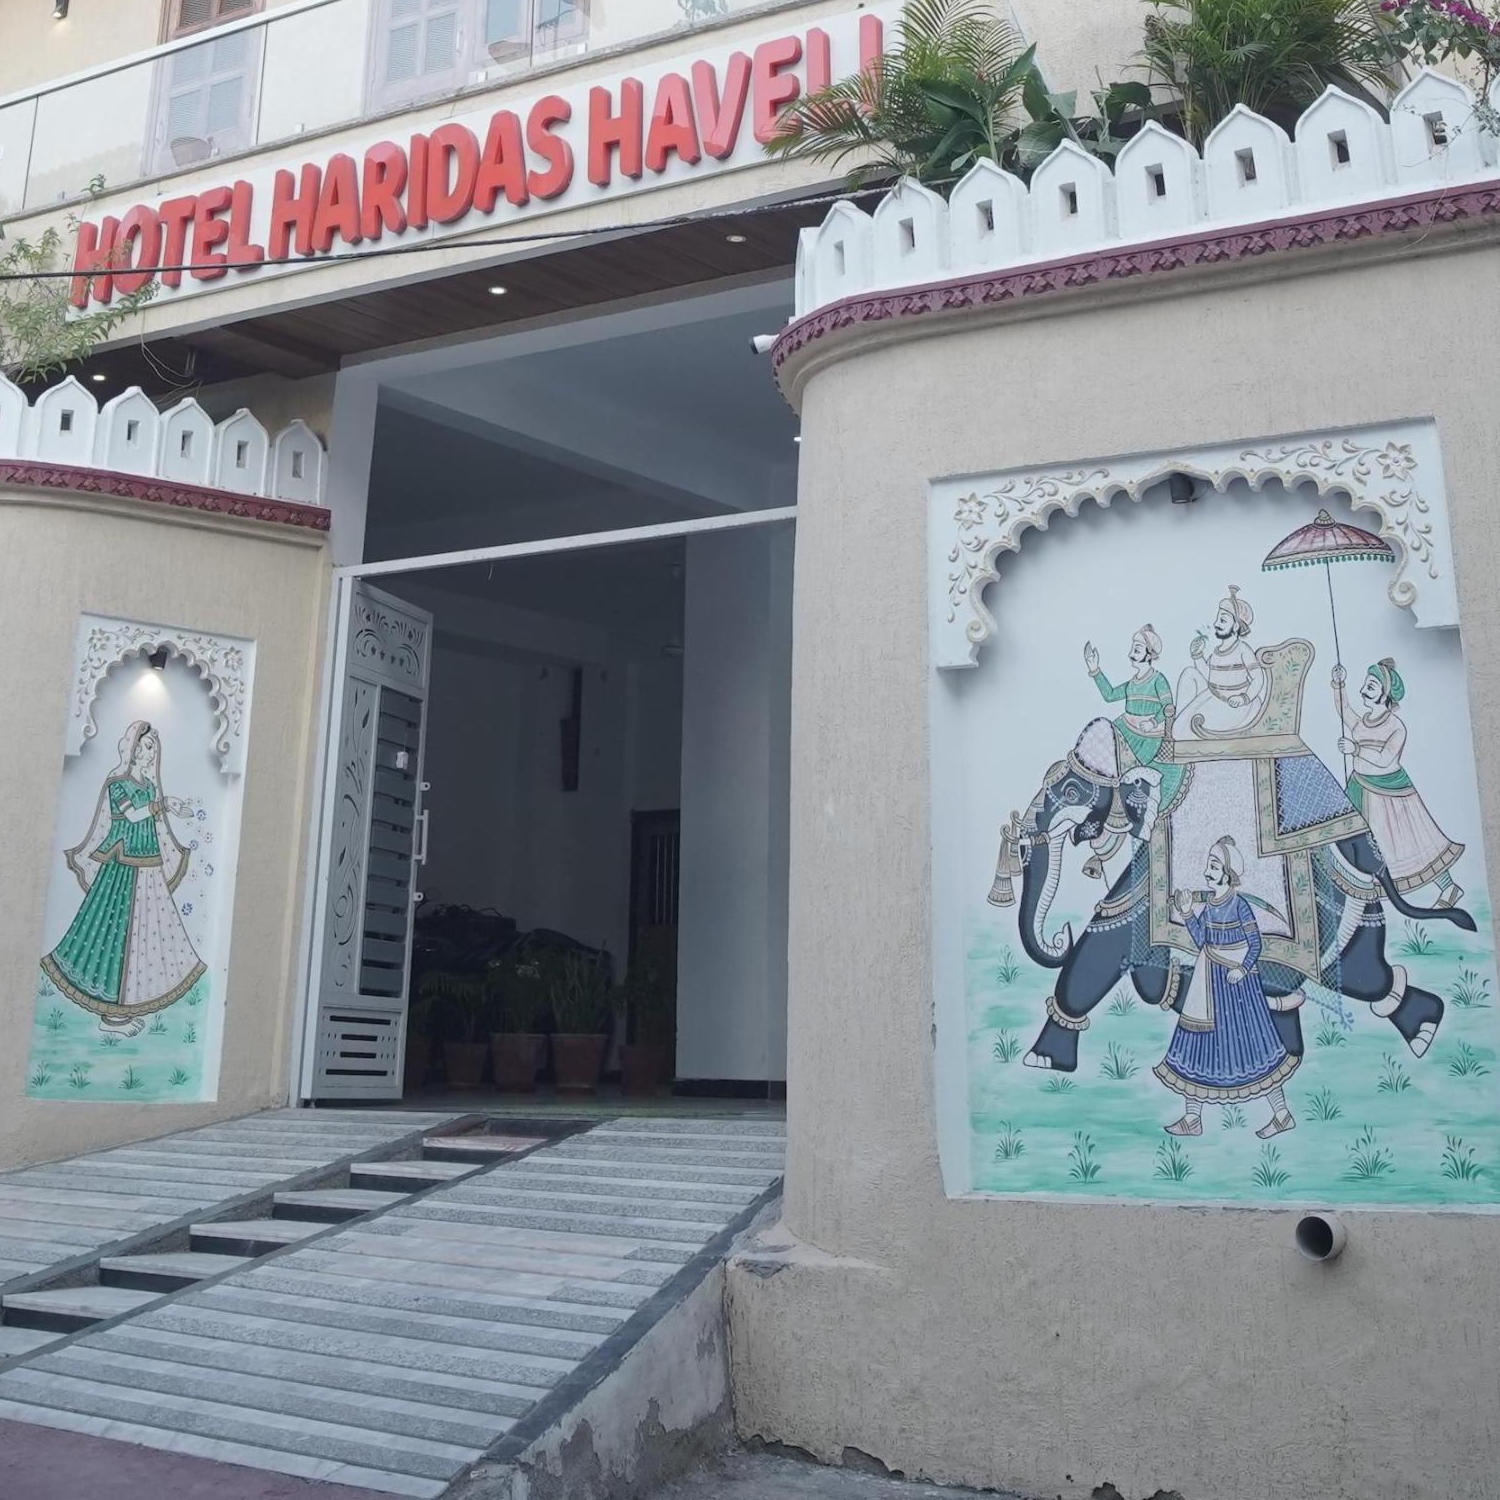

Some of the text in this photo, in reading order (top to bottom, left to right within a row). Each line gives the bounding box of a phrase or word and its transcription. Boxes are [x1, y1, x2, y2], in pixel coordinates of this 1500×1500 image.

[69, 13, 884, 309] HOTEL HARIDAS HAVELI
